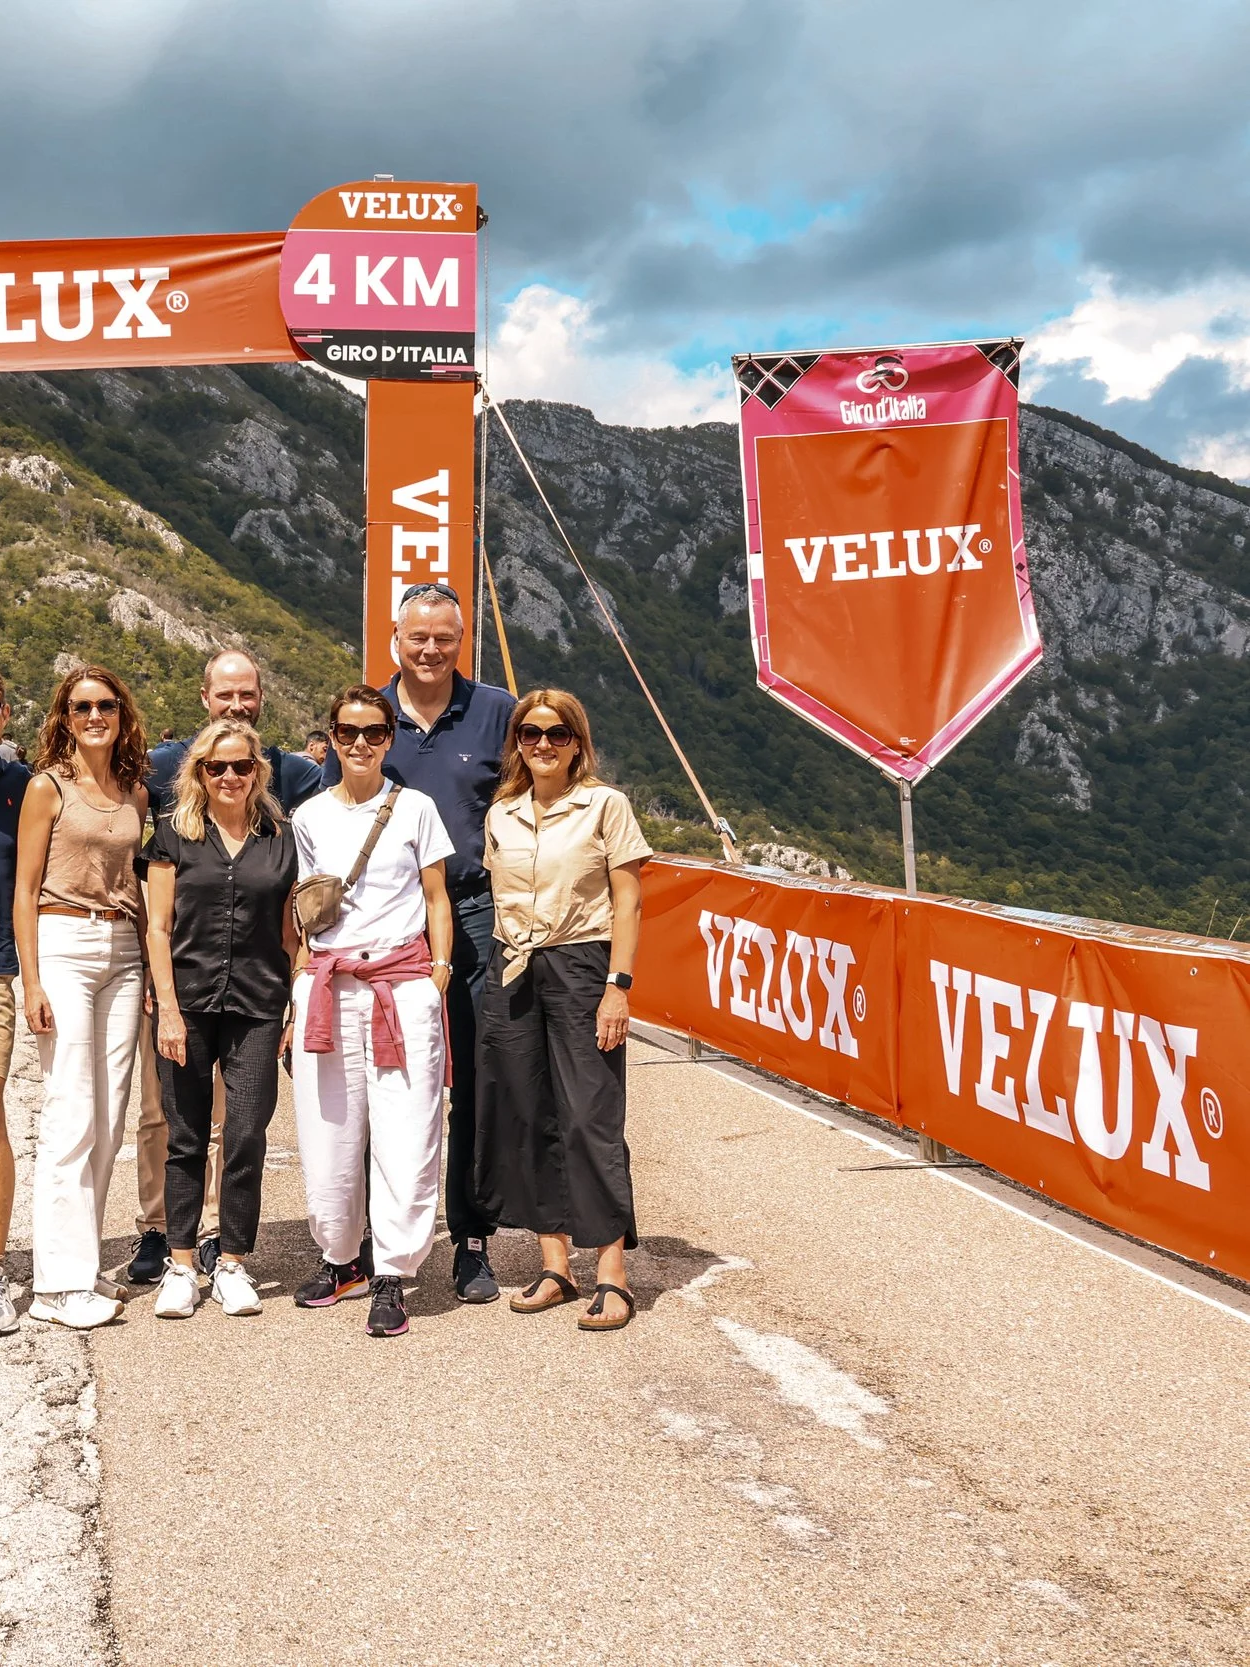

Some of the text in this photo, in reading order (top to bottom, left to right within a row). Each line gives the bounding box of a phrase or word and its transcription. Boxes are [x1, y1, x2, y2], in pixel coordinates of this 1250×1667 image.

[293, 253, 459, 308] 4 KM
[326, 345, 378, 363] GIRO
[839, 399, 874, 425] Giro
